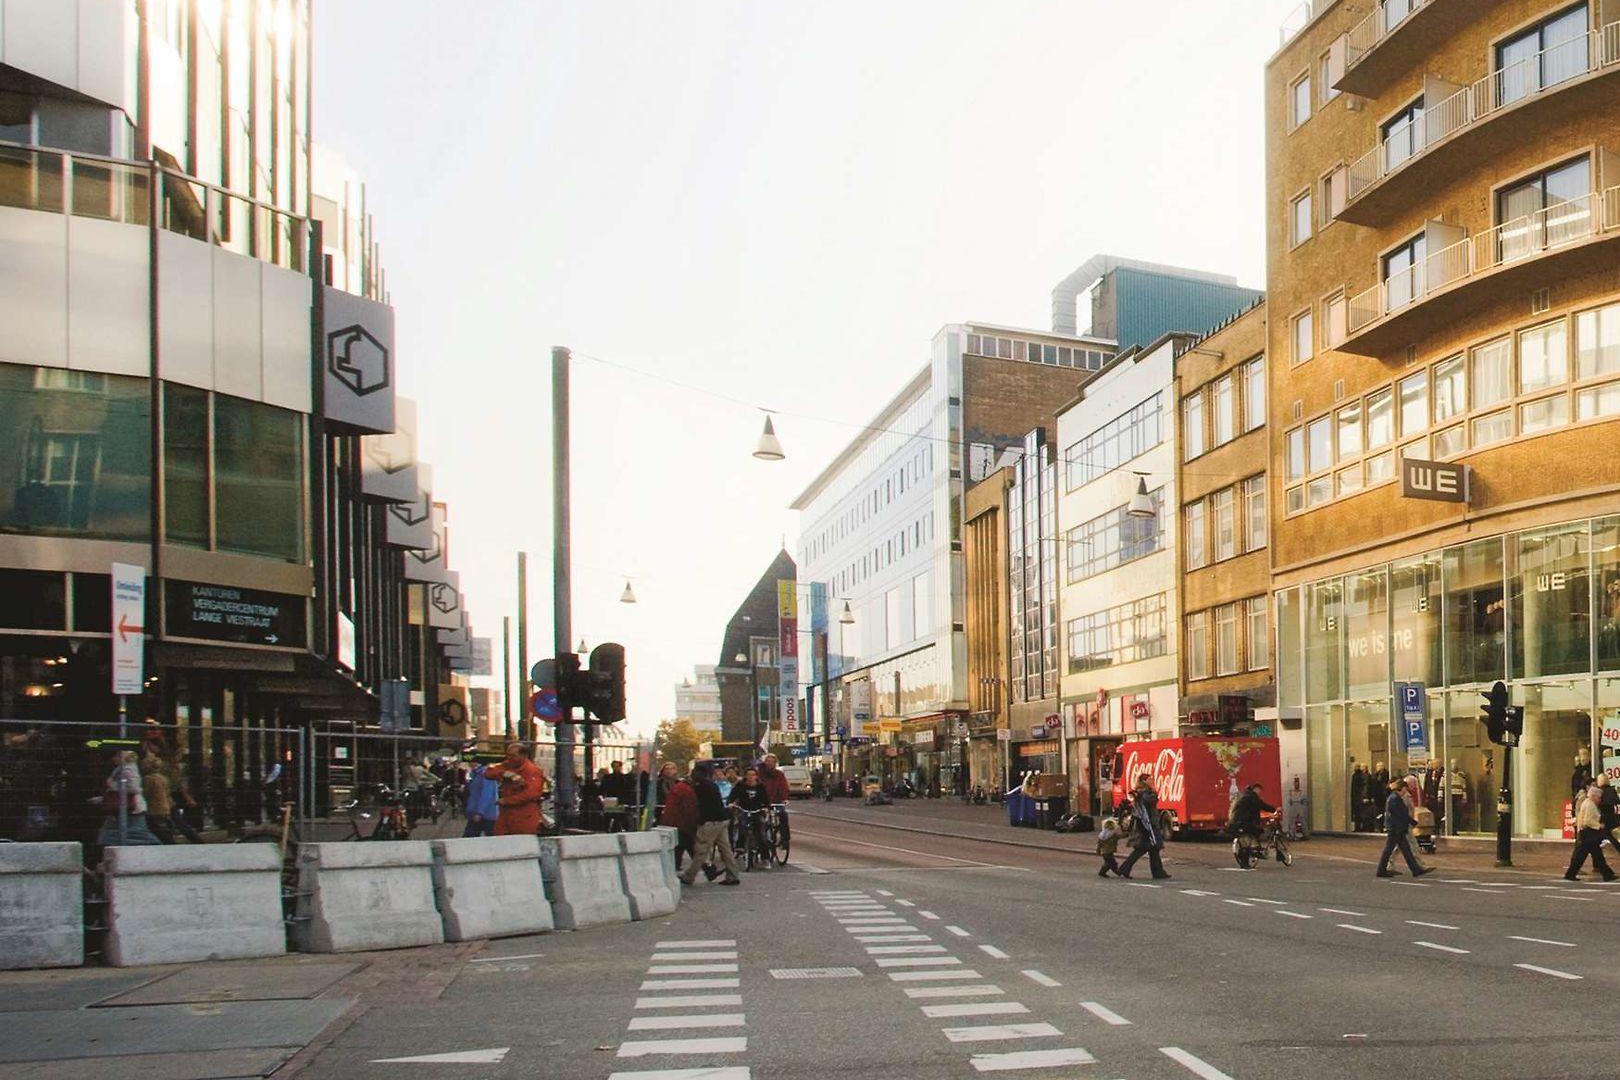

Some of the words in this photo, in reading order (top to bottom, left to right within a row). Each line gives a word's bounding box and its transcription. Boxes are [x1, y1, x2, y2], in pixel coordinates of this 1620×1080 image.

[1410, 466, 1458, 494] WE
[1536, 572, 1567, 593] WE
[1348, 636, 1368, 658] we
[1371, 629, 1385, 654] is
[1406, 688, 1417, 703] P
[786, 697, 796, 731] pipoos
[1409, 722, 1420, 736] P
